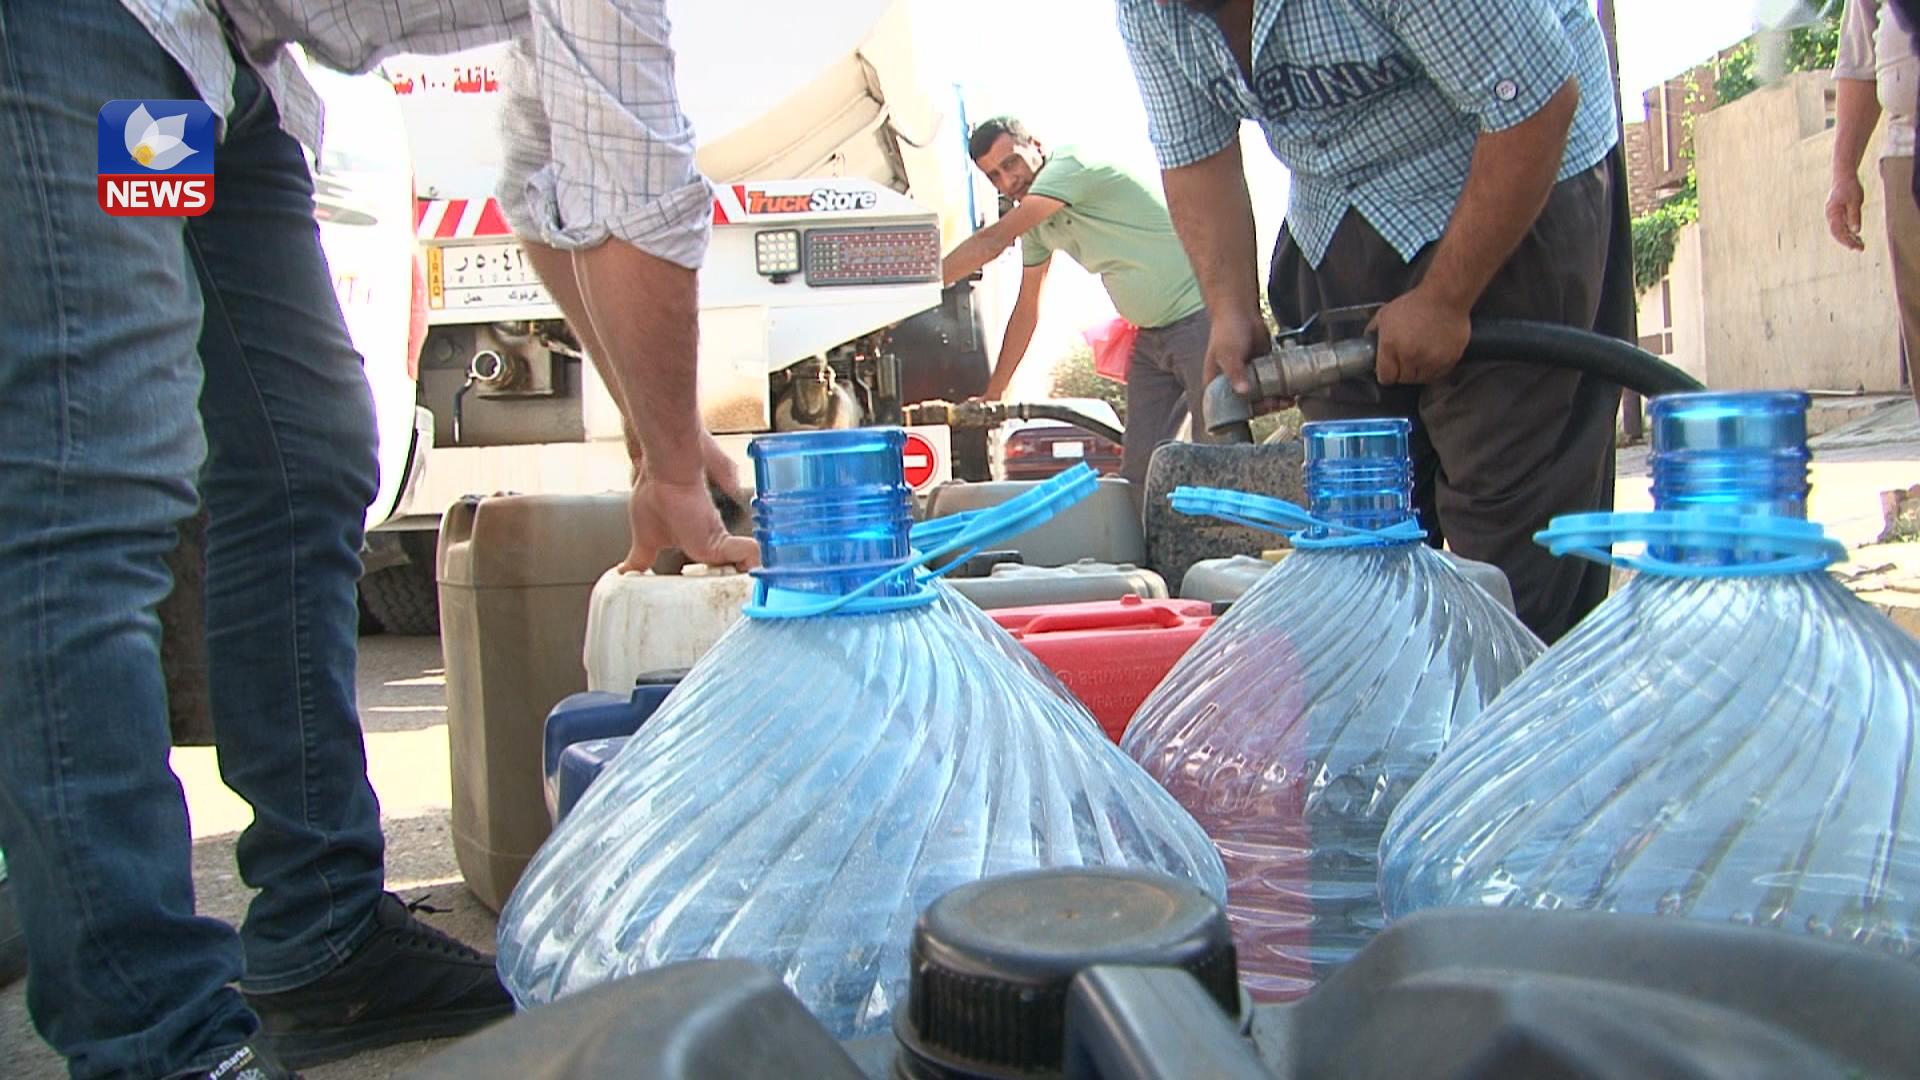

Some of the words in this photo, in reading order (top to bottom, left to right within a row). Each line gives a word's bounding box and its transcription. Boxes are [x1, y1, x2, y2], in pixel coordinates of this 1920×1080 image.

[421, 73, 446, 91] ١٠٠
[453, 65, 499, 93] ناقلة
[748, 188, 877, 214] TruckStore
[431, 251, 442, 297] IRAQ
